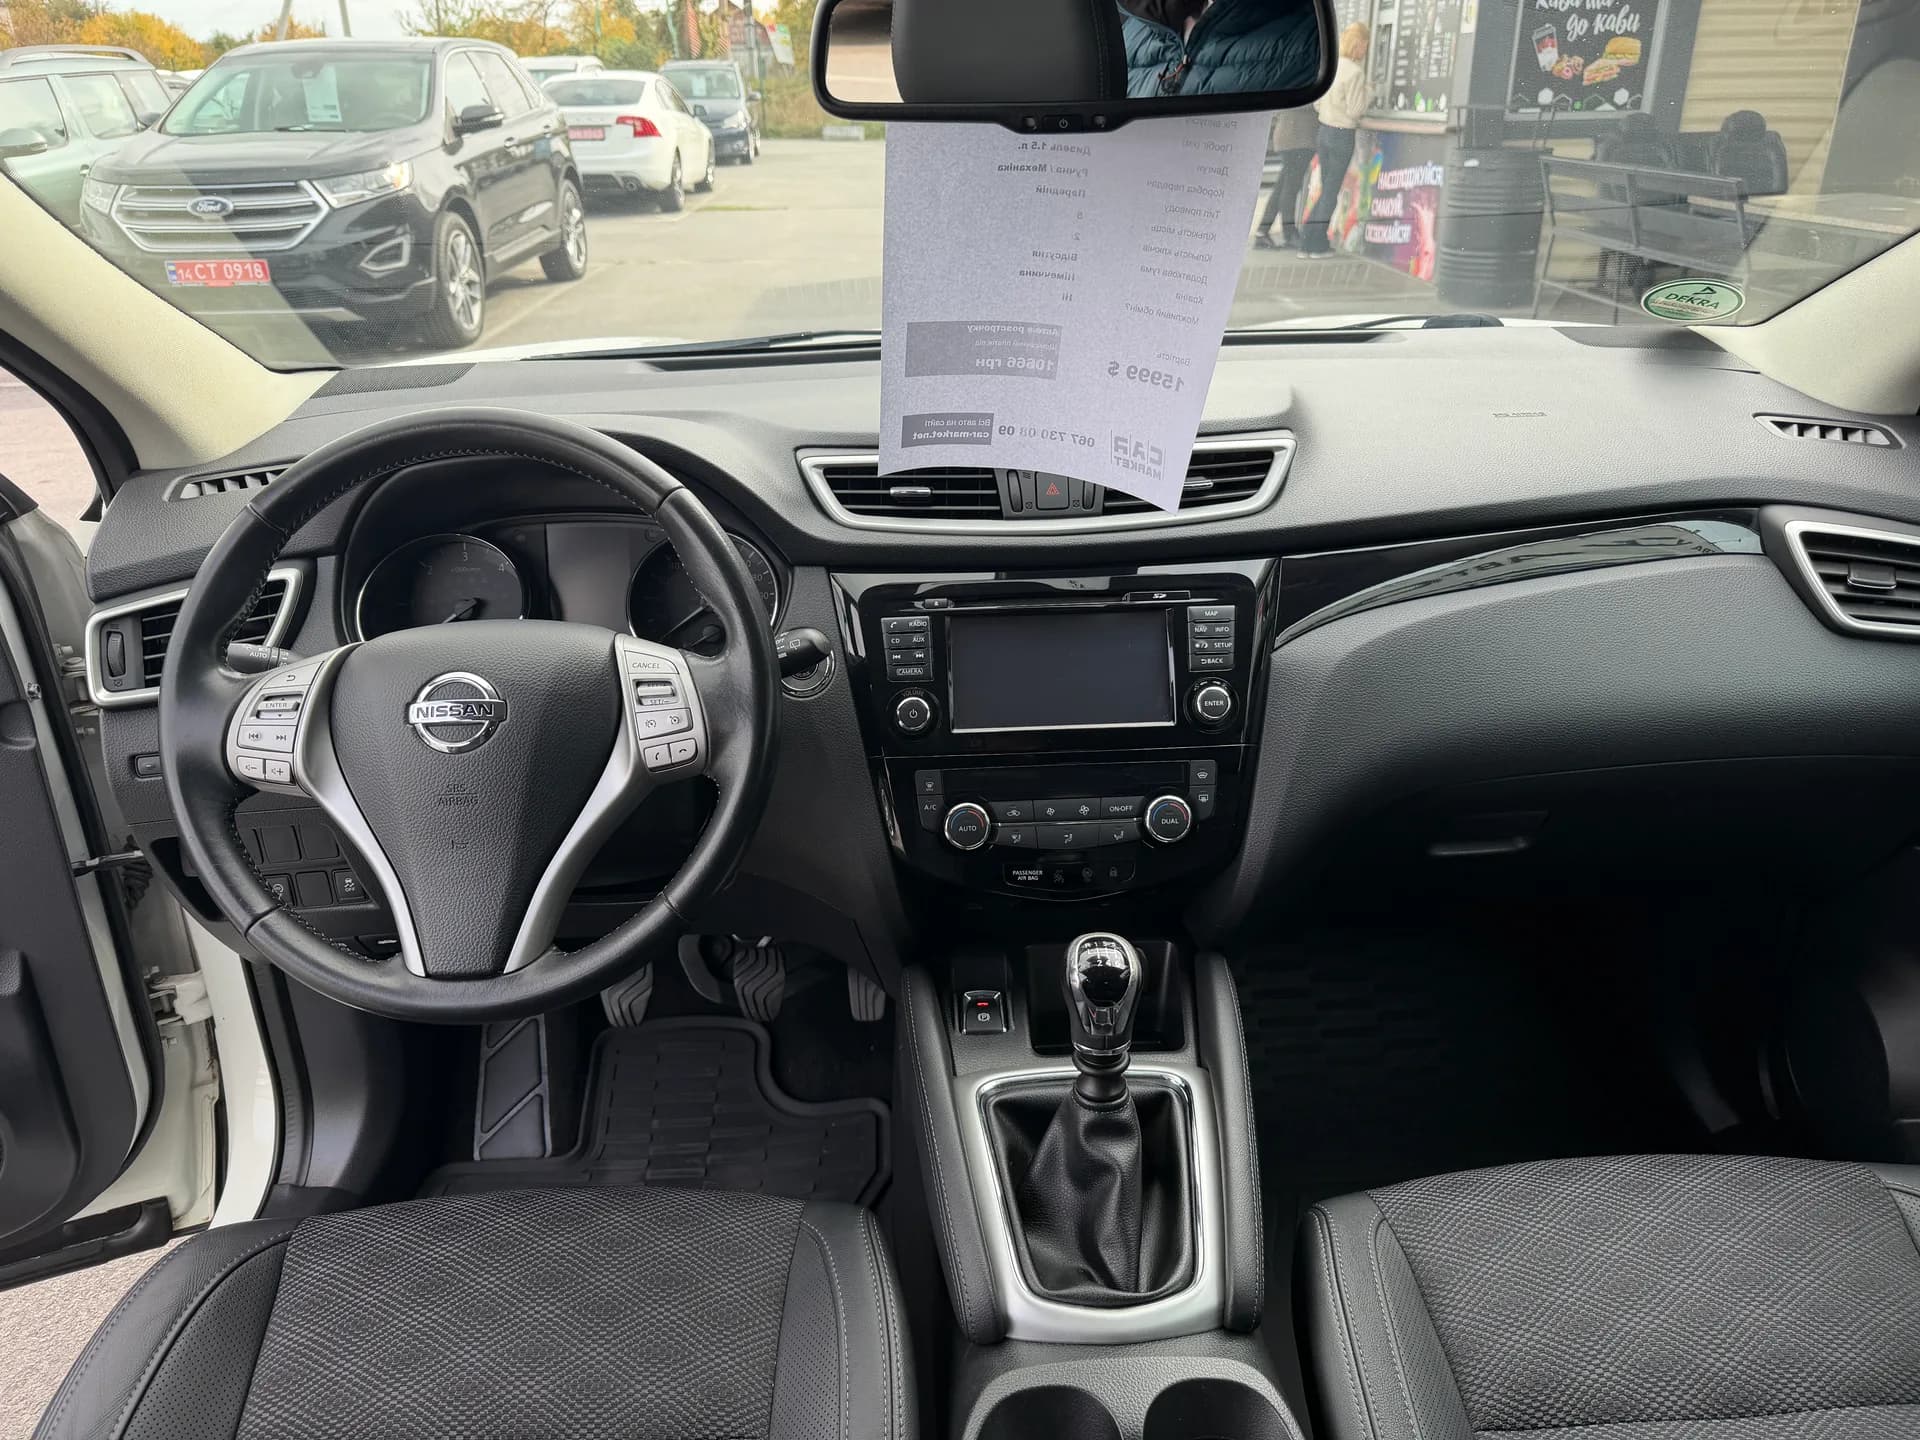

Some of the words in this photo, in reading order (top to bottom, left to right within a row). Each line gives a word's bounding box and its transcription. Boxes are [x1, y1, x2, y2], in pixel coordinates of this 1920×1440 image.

[1566, 13, 1589, 42] до
[1592, 4, 1640, 35] кави
[196, 200, 222, 212] Ford
[223, 262, 264, 280] 0918
[1665, 293, 1720, 310] DEKRA
[908, 620, 928, 628] RADIO
[249, 651, 268, 660] AUTO
[631, 661, 661, 670] CANCEL
[416, 703, 494, 719] NISSAN
[446, 783, 467, 793] SRS
[437, 795, 479, 806] AIRBAG
[923, 803, 937, 811] A/C
[958, 825, 977, 833] AUTO
